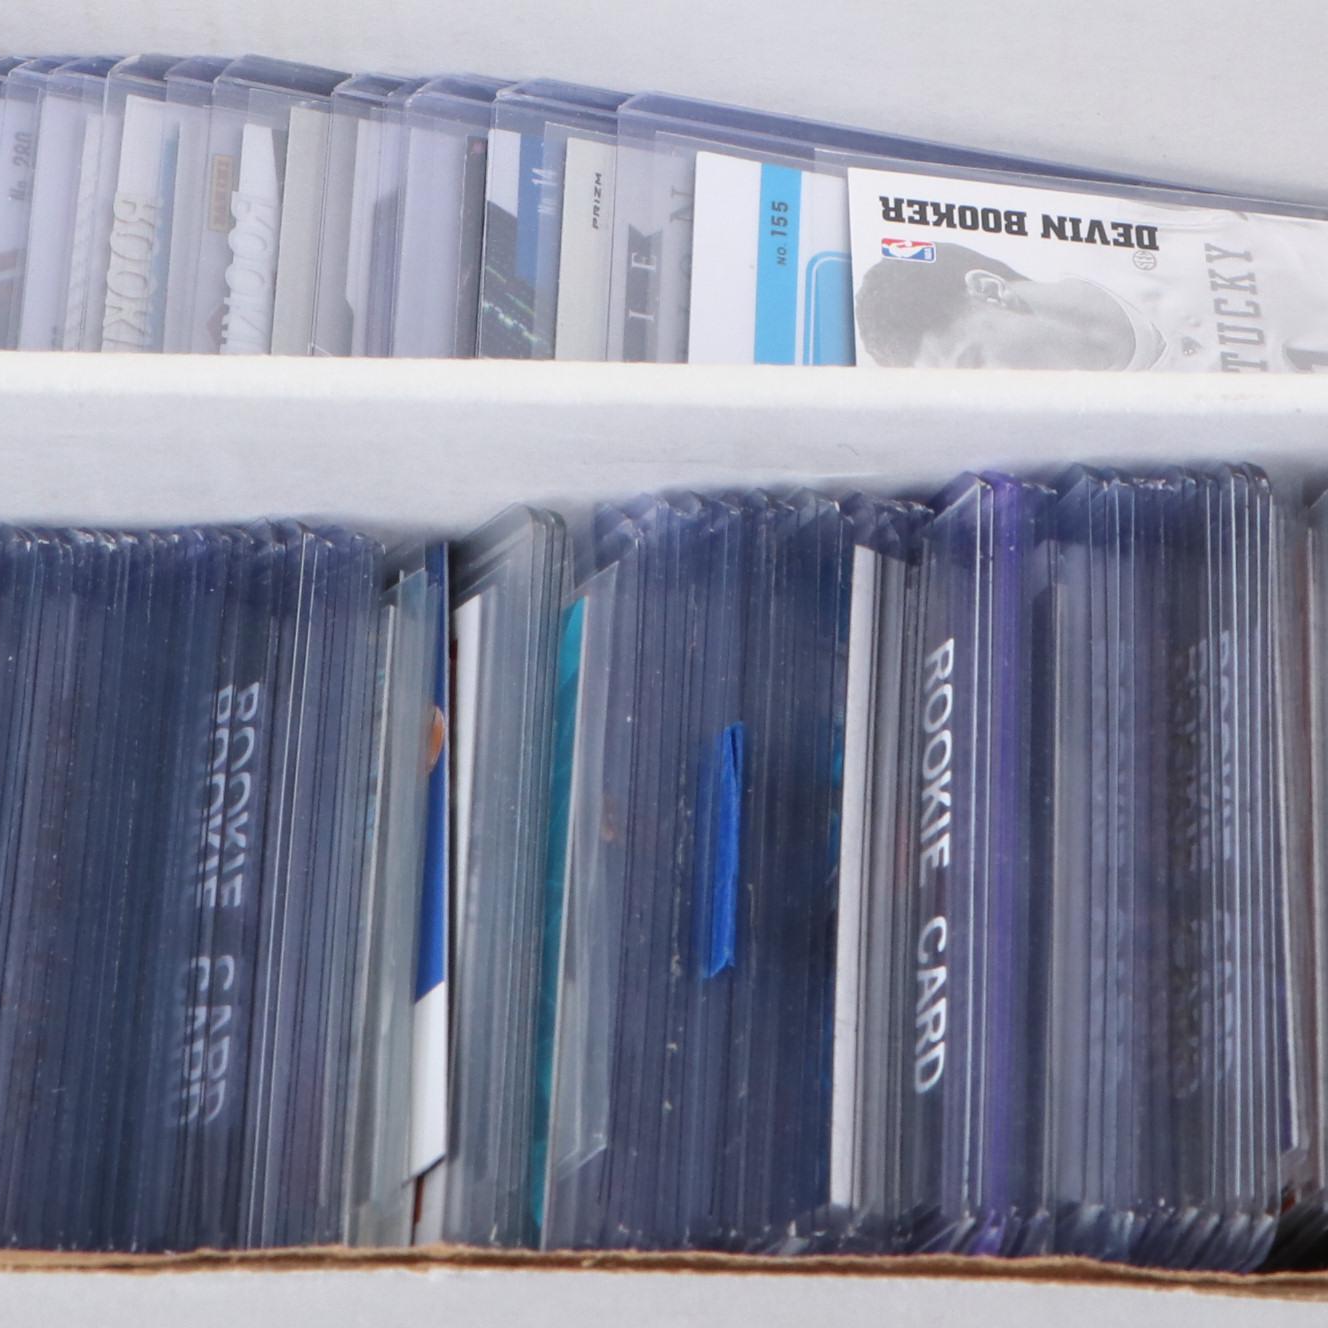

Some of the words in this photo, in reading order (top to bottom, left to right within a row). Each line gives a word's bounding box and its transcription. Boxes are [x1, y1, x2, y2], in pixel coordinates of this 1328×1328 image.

[591, 171, 604, 230] PRIZM
[771, 200, 789, 237] 155
[878, 195, 1029, 237] BOOKER
[1040, 213, 1160, 251] DEVIN
[918, 636, 955, 887] ROOKIE
[913, 915, 949, 1096] CARD
